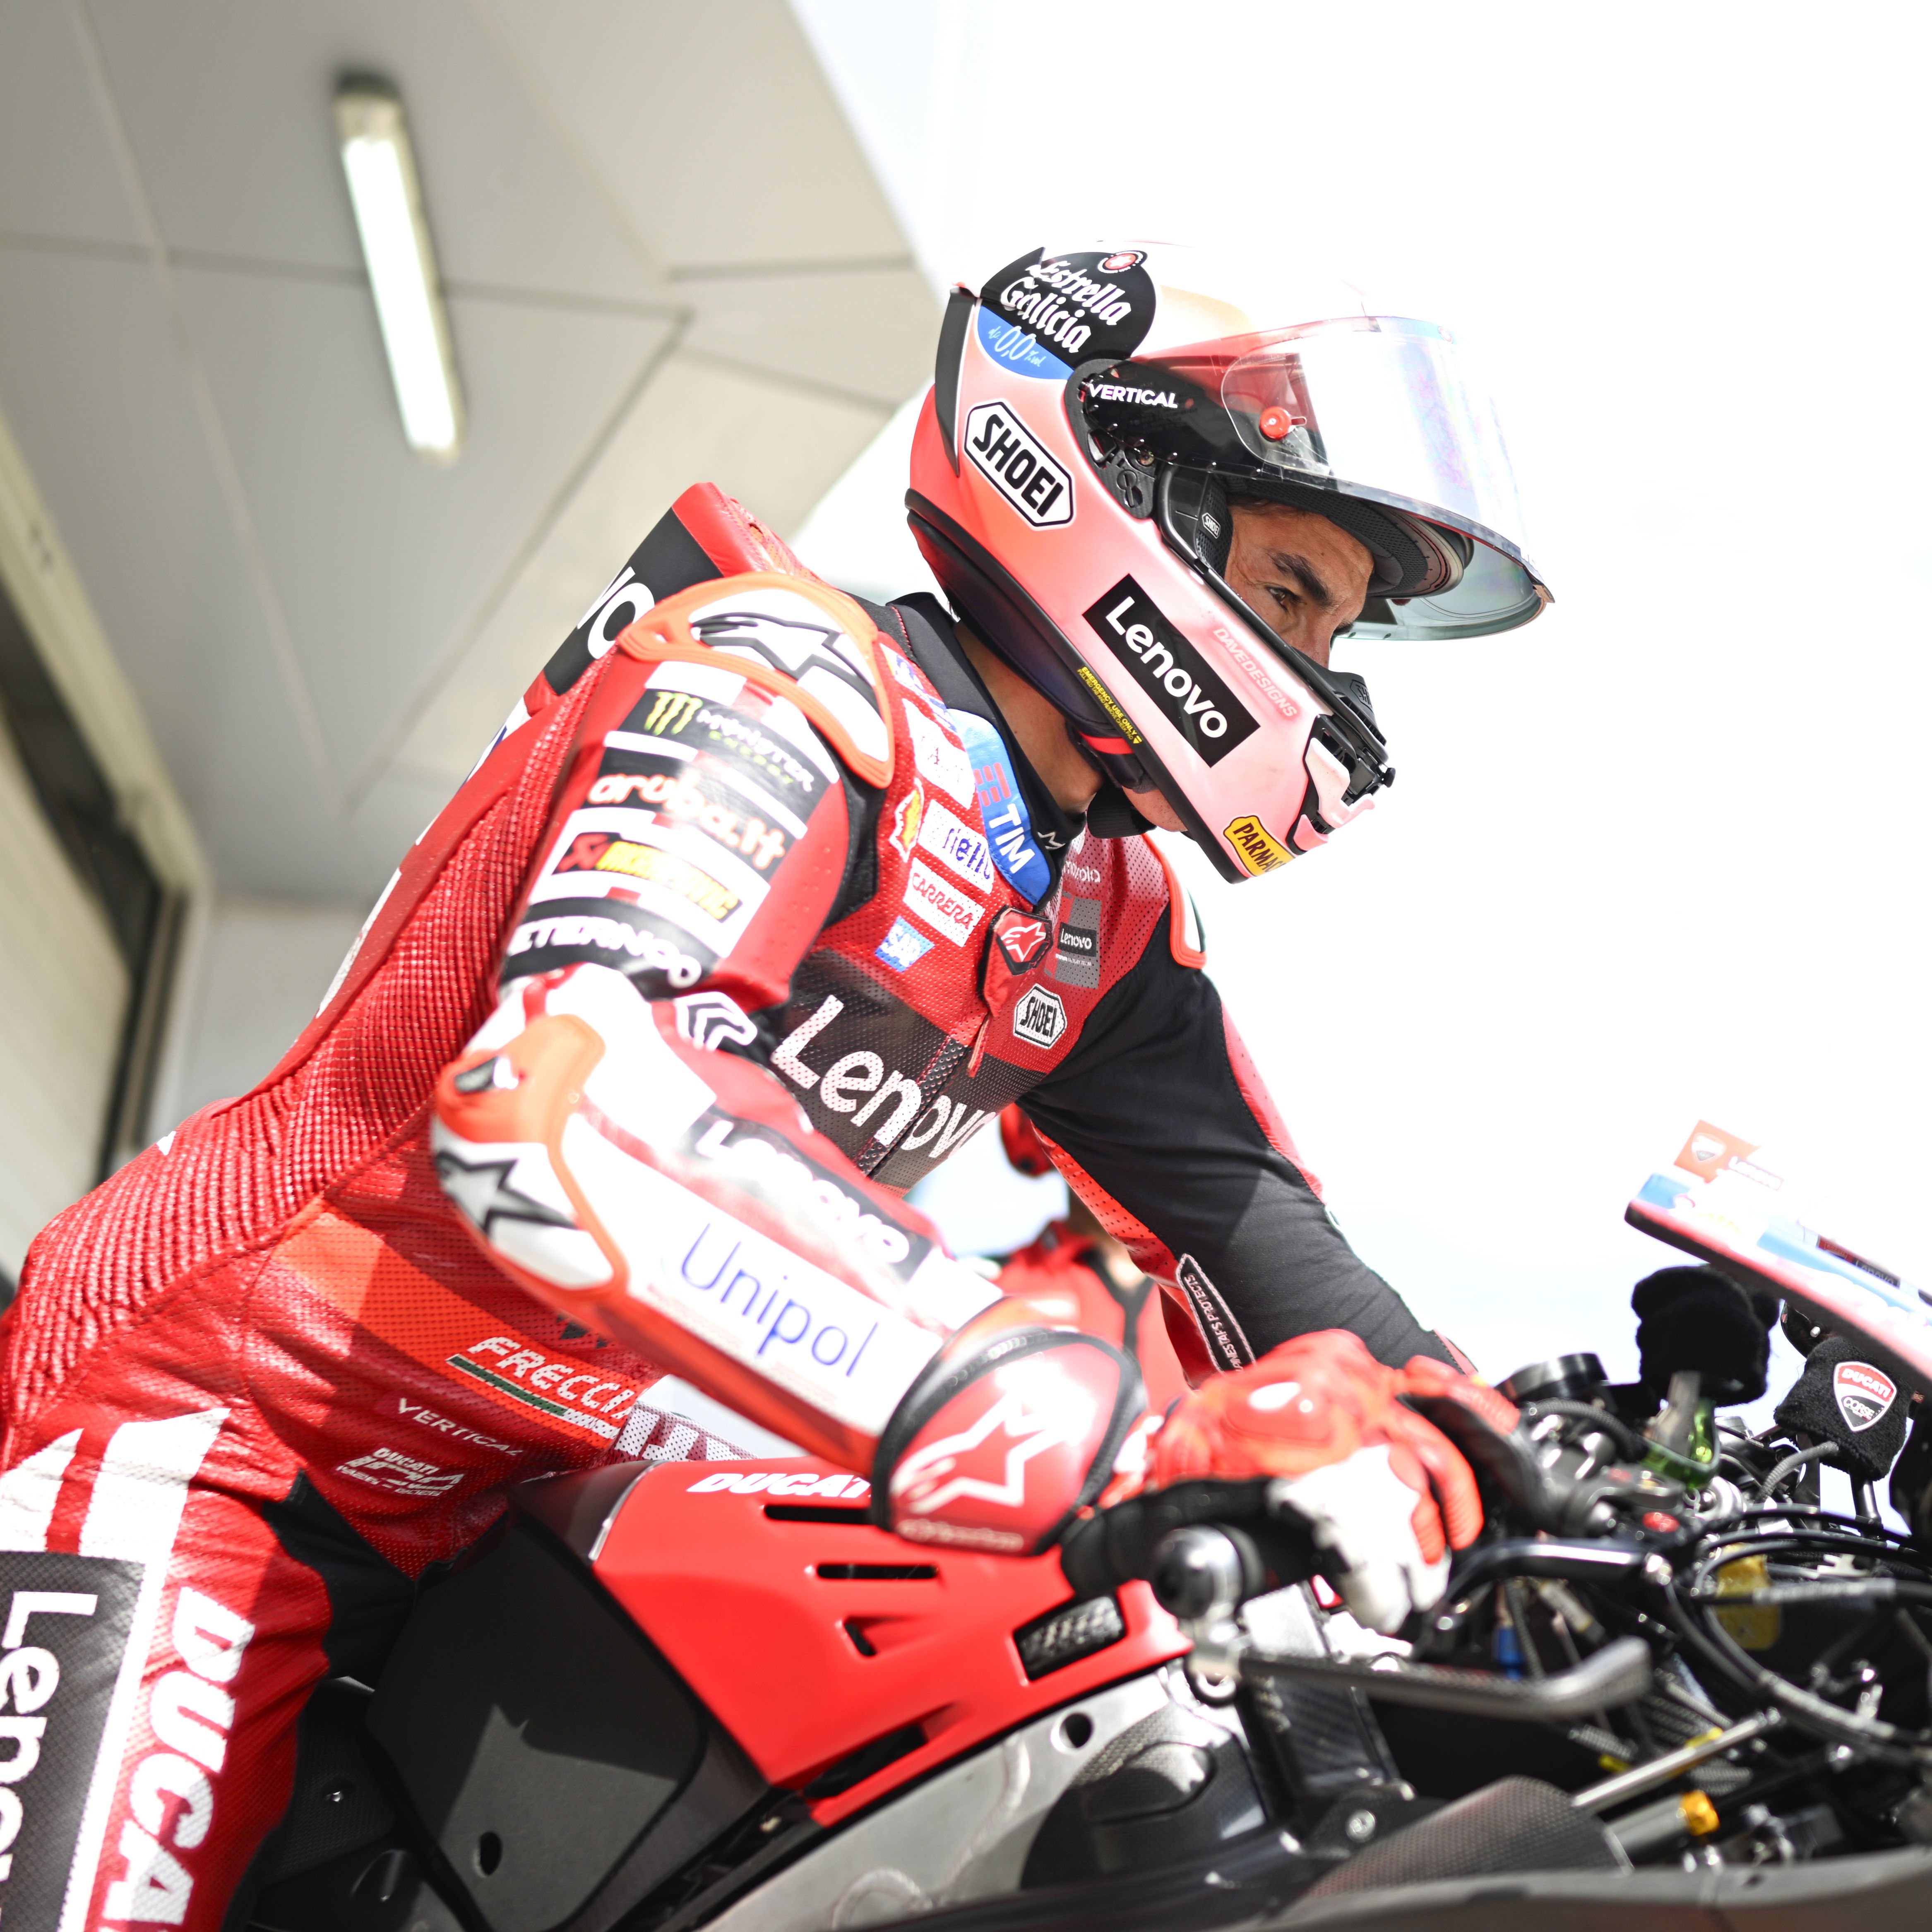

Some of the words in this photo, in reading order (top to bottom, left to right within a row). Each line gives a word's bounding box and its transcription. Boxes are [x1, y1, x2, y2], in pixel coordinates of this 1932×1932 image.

[1000, 276, 1091, 353] Galicia
[1025, 261, 1132, 325] Estrella
[994, 325, 1037, 360] 0,0
[1089, 383, 1178, 409] VERTICAL
[973, 414, 1064, 517] SHOEI
[1205, 516, 1220, 536] SHOEI
[1105, 596, 1227, 738] Lenovo
[1077, 669, 1088, 680] PULL
[1085, 678, 1094, 688] RED
[1091, 686, 1100, 696] TAB
[1097, 694, 1106, 704] AND
[1103, 702, 1118, 719] REMOVE
[1115, 717, 1128, 732] CHEEK
[1125, 730, 1134, 740] PAD
[1081, 666, 1113, 705] EMERGENCY
[1111, 704, 1123, 718] USE
[1121, 718, 1137, 736] ONLY
[989, 803, 1036, 874] TIM
[912, 872, 975, 930] CARRERA
[1060, 928, 1092, 949] Lenovo
[1020, 996, 1057, 1038] SHOEI
[681, 1222, 879, 1378] Unipol
[1842, 1368, 1891, 1398] DUCATI
[1843, 1396, 1875, 1421] CORSE
[397, 1398, 525, 1457] VERTICAL
[373, 1447, 440, 1475] DUCATI
